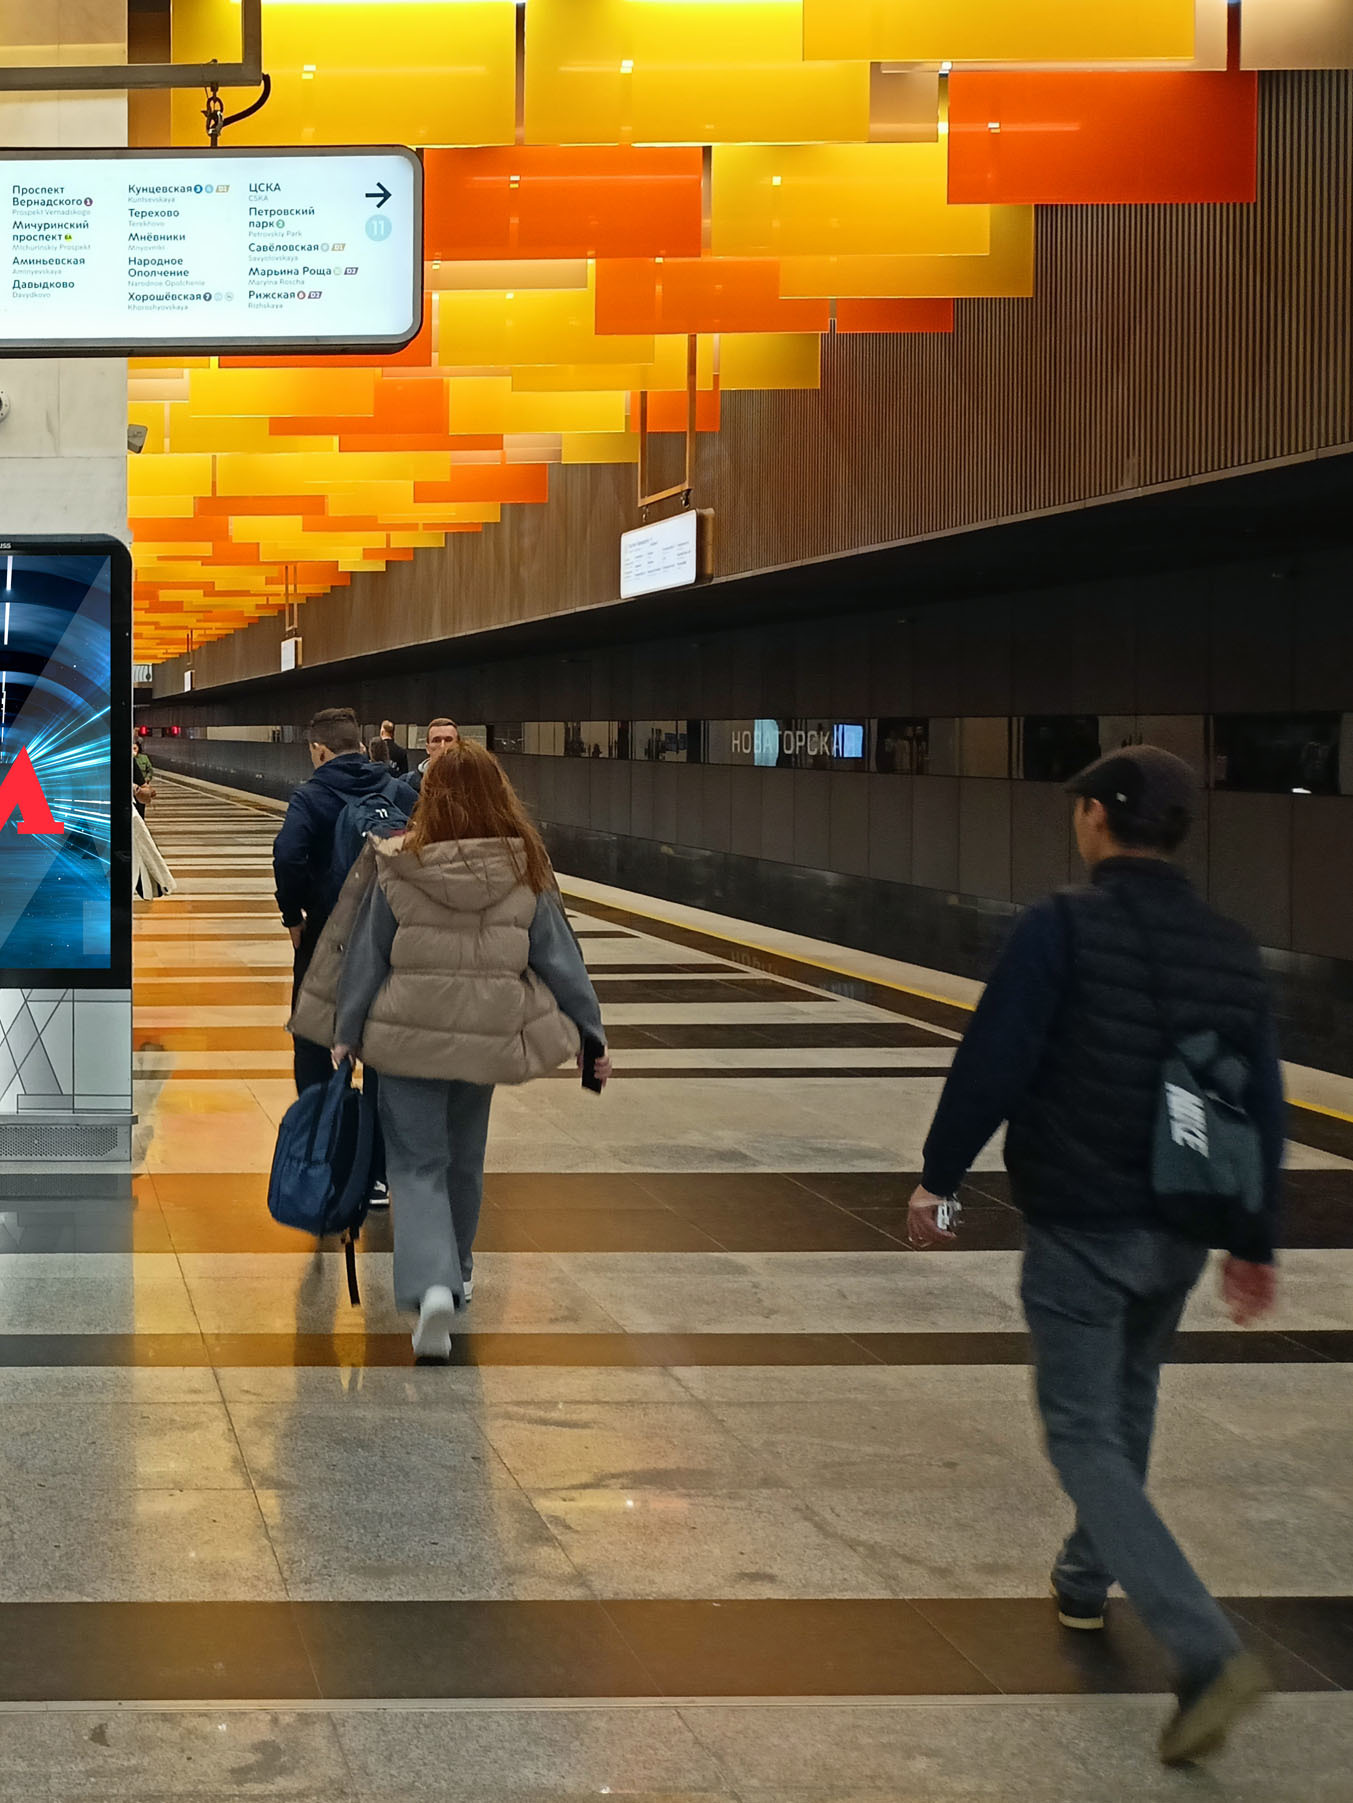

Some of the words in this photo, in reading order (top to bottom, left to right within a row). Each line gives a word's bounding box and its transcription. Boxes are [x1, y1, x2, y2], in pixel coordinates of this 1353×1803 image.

[12, 185, 64, 196] Проспект
[128, 184, 192, 195] Кунцевская
[249, 182, 281, 193] ЦСКА
[12, 197, 83, 207] Вернадского
[128, 208, 180, 219] Терехово
[249, 206, 315, 218] Петровский
[12, 220, 89, 231] Мичуринский
[249, 220, 275, 229] парк
[12, 234, 62, 243] проспект
[128, 232, 185, 241] Мнёвники
[248, 242, 319, 252] Савёловская
[12, 256, 85, 265] Аминьевская
[128, 256, 183, 267] Народное
[128, 268, 189, 277] Ополчение
[248, 267, 299, 278] Марьина
[302, 266, 332, 276] Роща
[12, 279, 75, 290] Давыдково
[128, 292, 202, 303] Хорошёвская
[248, 290, 296, 299] Рижская
